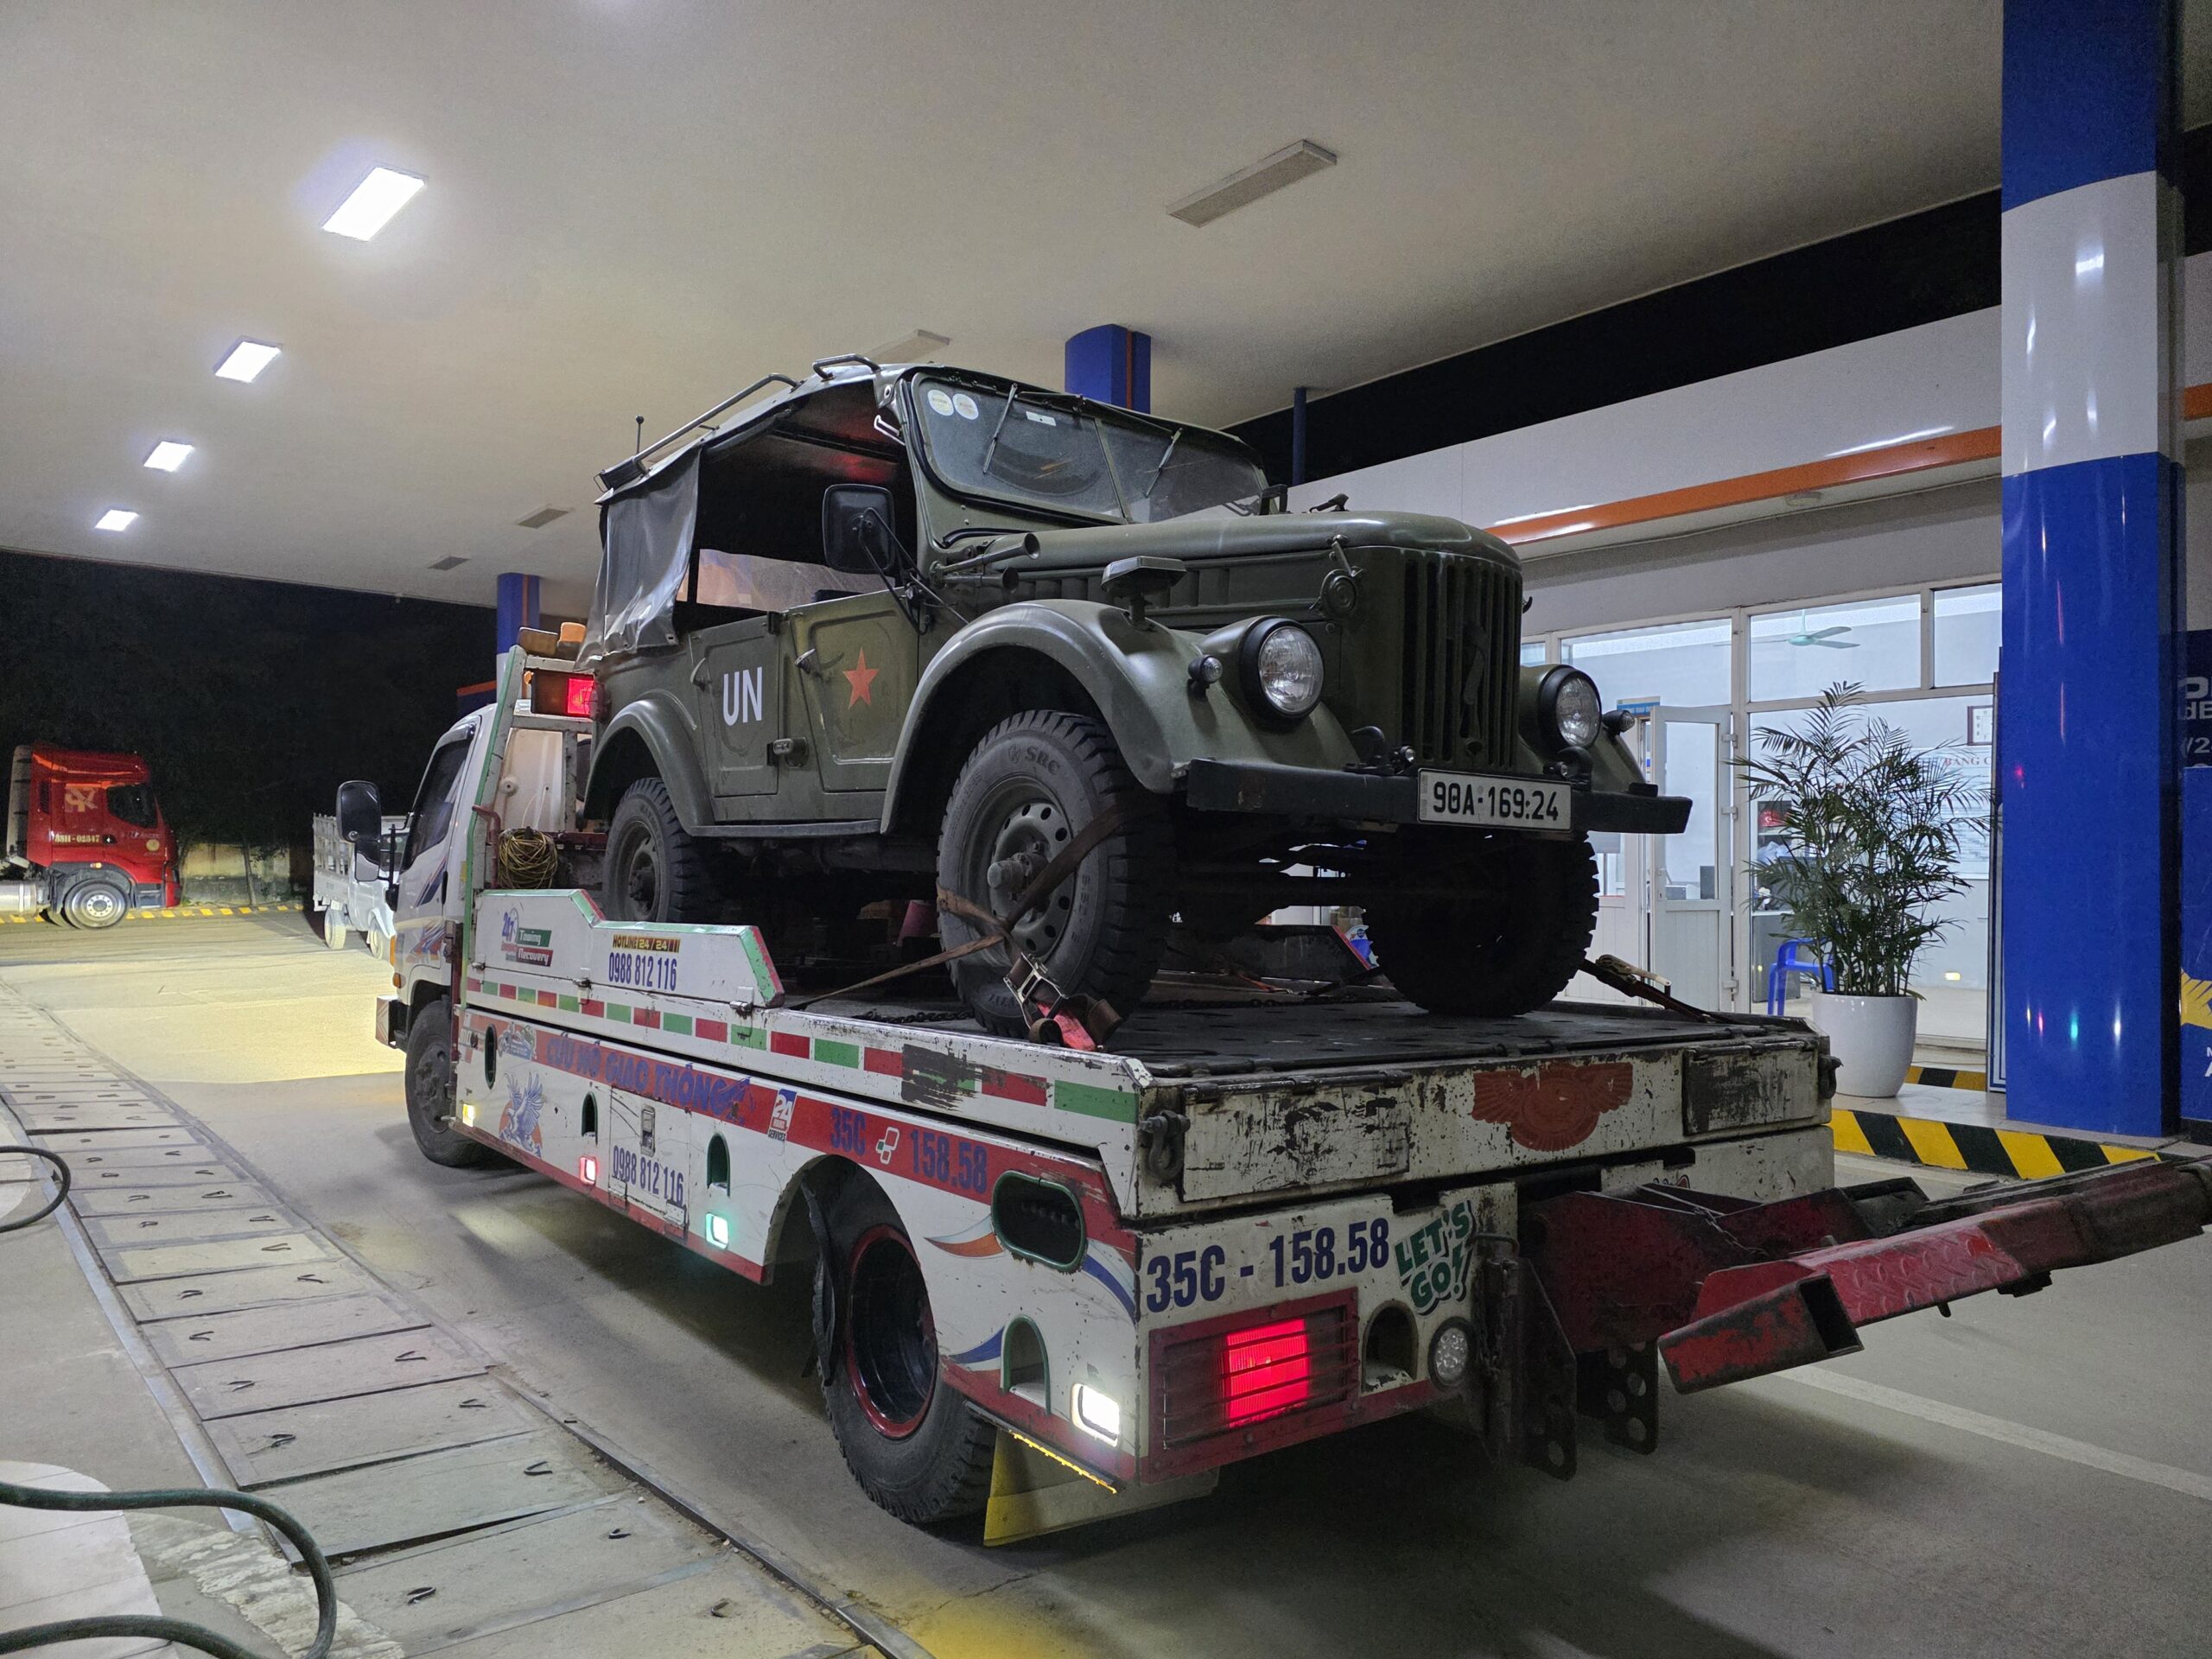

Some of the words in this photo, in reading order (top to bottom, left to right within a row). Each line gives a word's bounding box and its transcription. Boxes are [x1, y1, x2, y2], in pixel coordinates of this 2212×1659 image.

[722, 667, 763, 727] UN
[518, 948, 550, 965] Recovery
[519, 930, 542, 945] Towing
[613, 935, 639, 949] HOTLINE
[608, 952, 632, 984] 0988
[634, 954, 654, 987] 812
[658, 957, 677, 991] 116
[606, 1052, 648, 1091] GIAO
[772, 1093, 793, 1121] 24
[768, 1129, 785, 1141] SERVICES
[830, 1107, 867, 1156] 35C
[909, 1128, 988, 1194] 158.58
[613, 1145, 637, 1185] 0988
[639, 1156, 659, 1194] 812
[664, 1166, 683, 1206] 116
[1395, 1201, 1470, 1277] LET'S
[1147, 1245, 1225, 1313] 35C
[1268, 1217, 1389, 1288] 158.58
[1410, 1242, 1465, 1308] GO!
